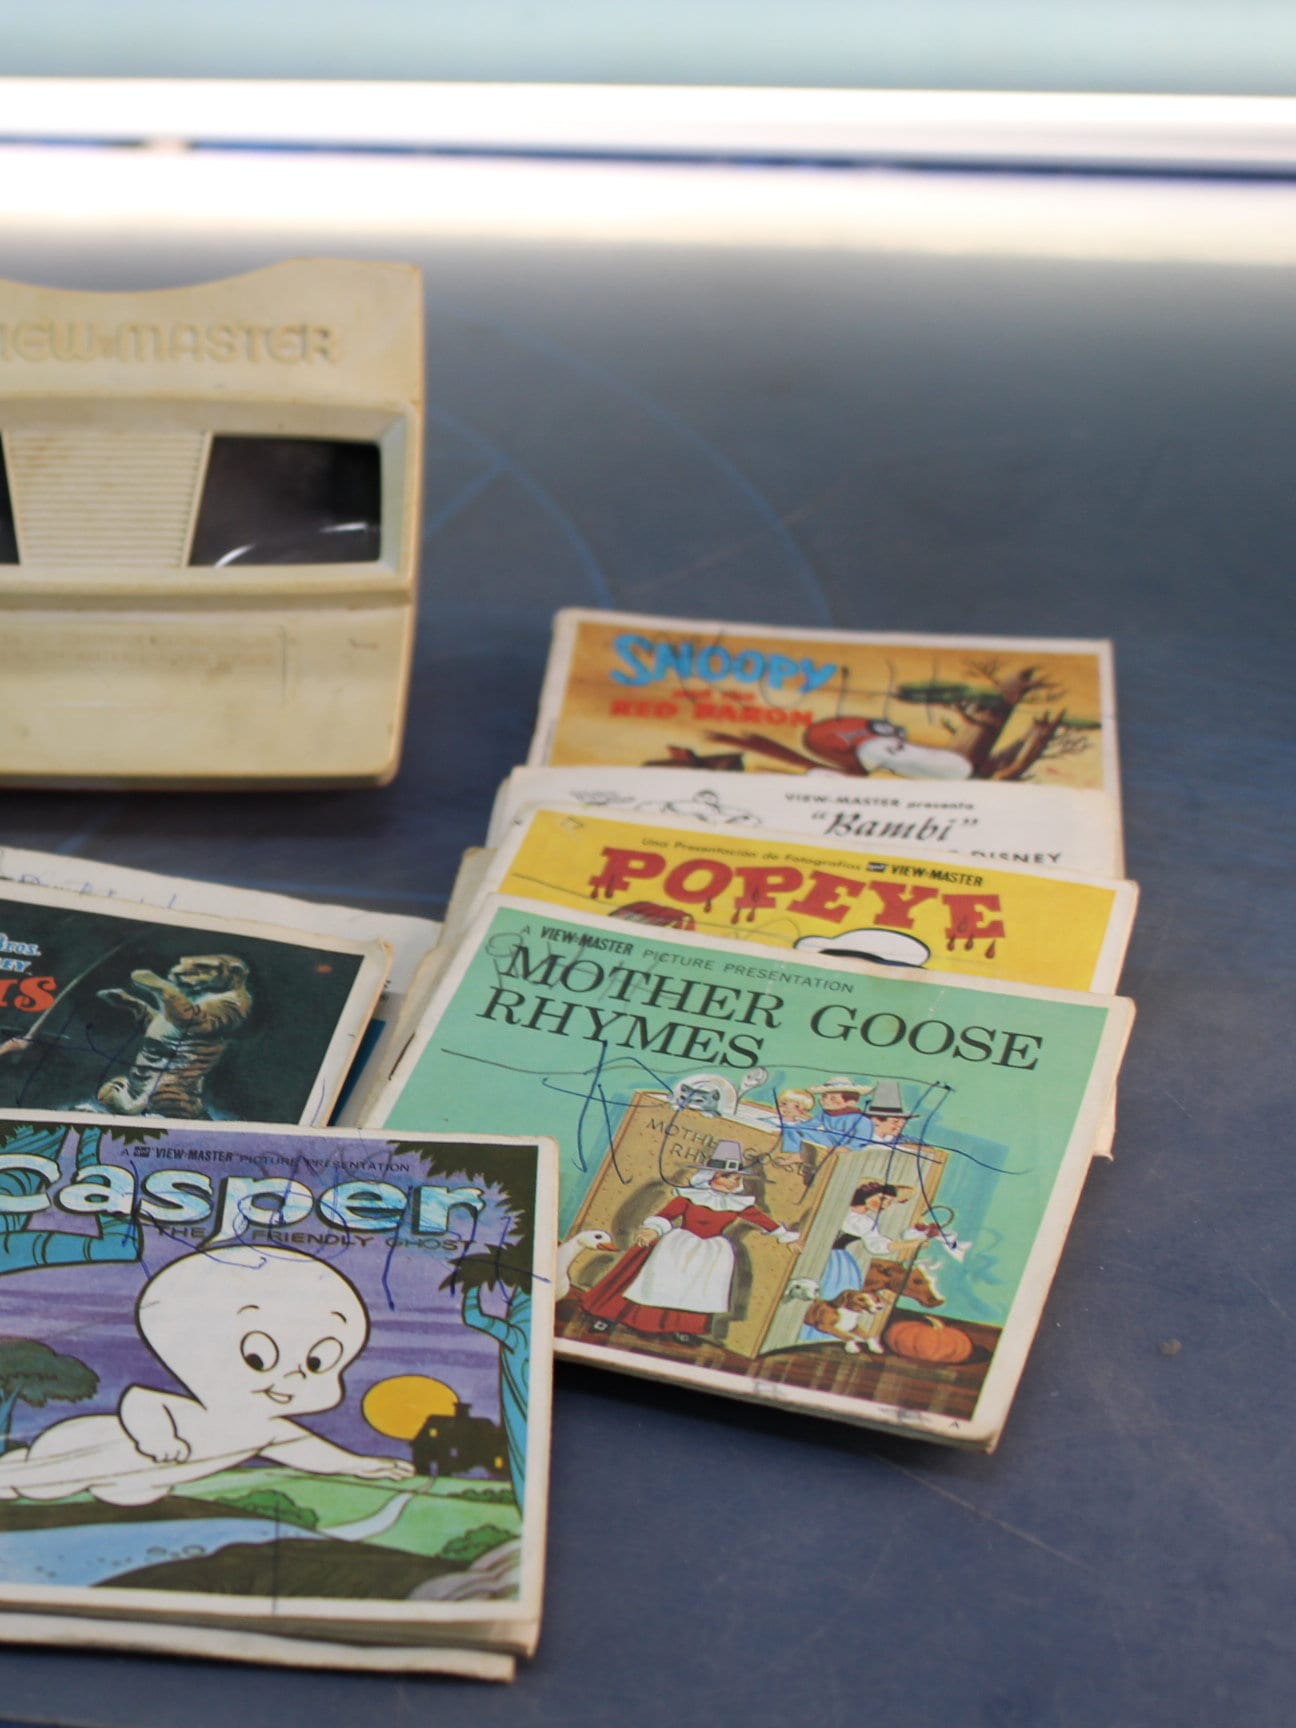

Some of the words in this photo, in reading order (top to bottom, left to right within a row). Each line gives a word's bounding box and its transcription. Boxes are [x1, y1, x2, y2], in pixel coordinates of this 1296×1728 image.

[609, 633, 838, 694] SNOOPY
[609, 699, 679, 719] RED
[692, 703, 814, 728] BARON
[762, 853, 779, 862] de
[589, 847, 1006, 945] POPEYE
[522, 925, 531, 935] A
[642, 949, 718, 973] PICTURE
[723, 963, 855, 996] PRESENTATION
[475, 985, 766, 1071] RHYMES
[500, 943, 786, 1029] MOTHER
[809, 1003, 1046, 1072] GOOSE
[646, 1118, 719, 1148] MOTHE
[121, 1148, 131, 1157] A
[240, 1154, 301, 1168] PICTURE
[304, 1157, 411, 1173] PRESENTATION
[157, 1225, 204, 1240] THE
[251, 1228, 375, 1250] FRIENDLY
[386, 1237, 477, 1252] GHOST
